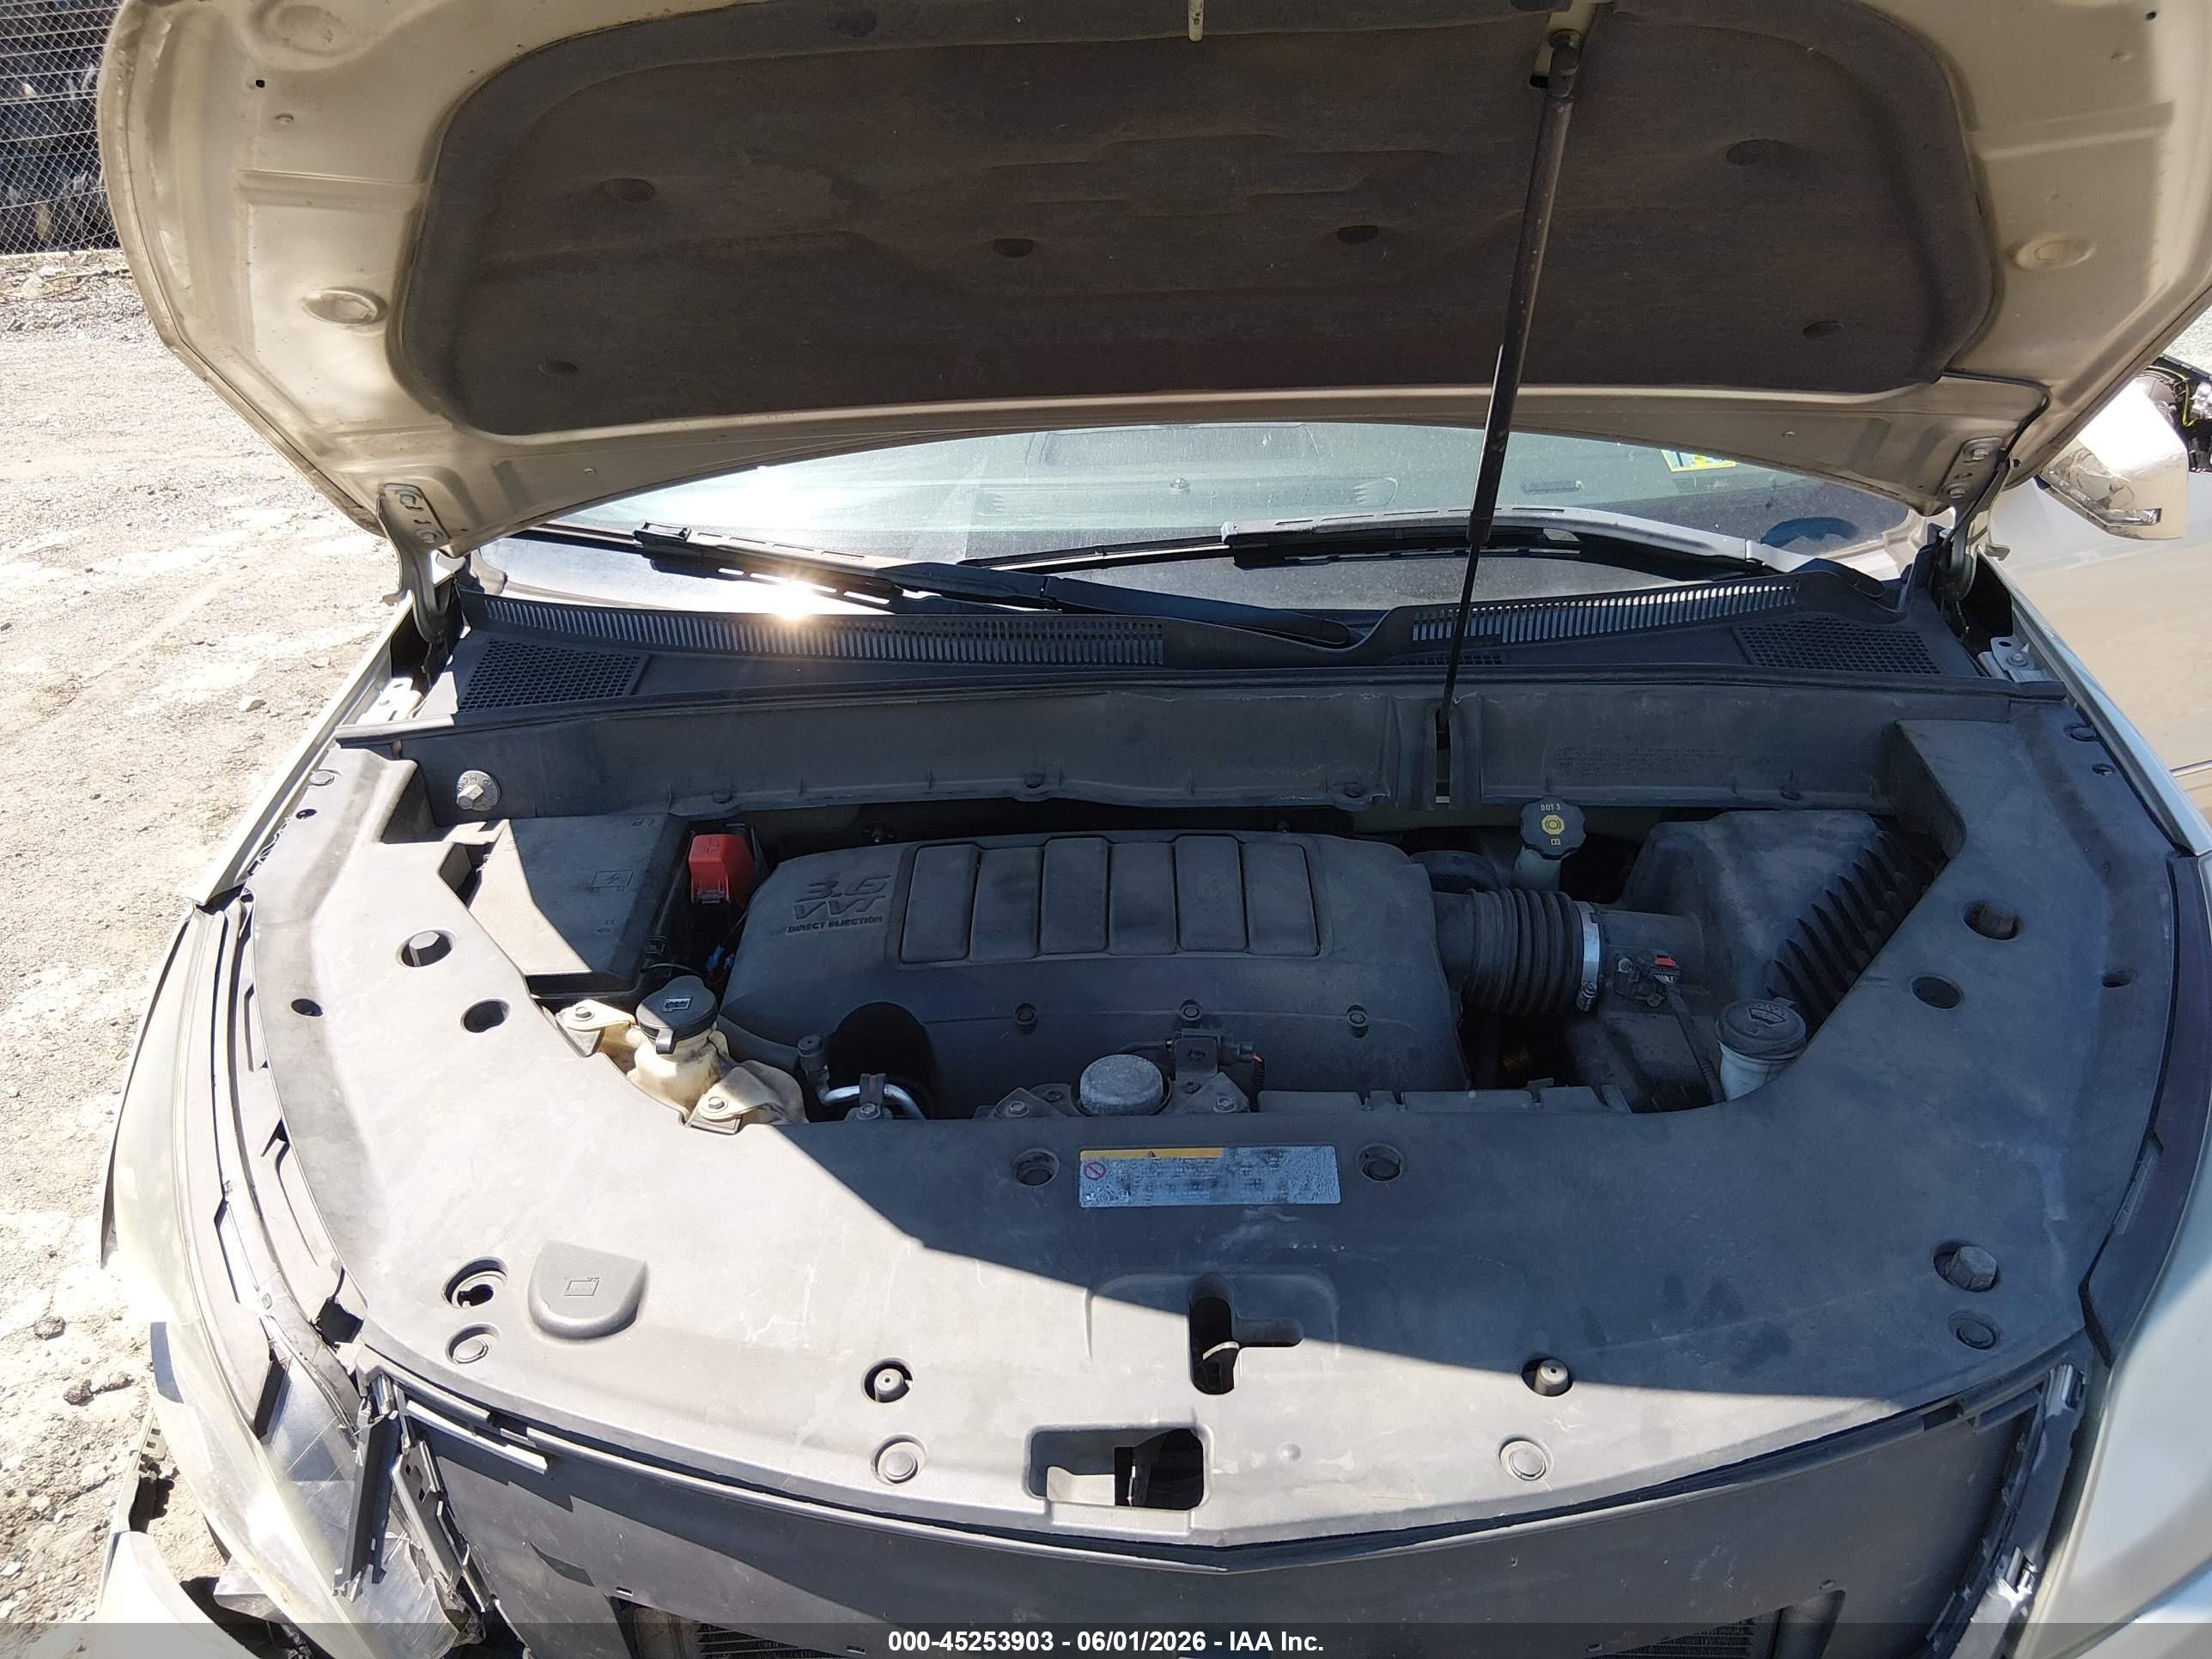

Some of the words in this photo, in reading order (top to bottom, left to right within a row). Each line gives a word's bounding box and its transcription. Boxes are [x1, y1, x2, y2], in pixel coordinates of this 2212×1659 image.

[794, 874, 891, 903] 3.6
[793, 895, 886, 920] VVT
[786, 921, 826, 933] DIRECT
[828, 915, 884, 927] INJECTION
